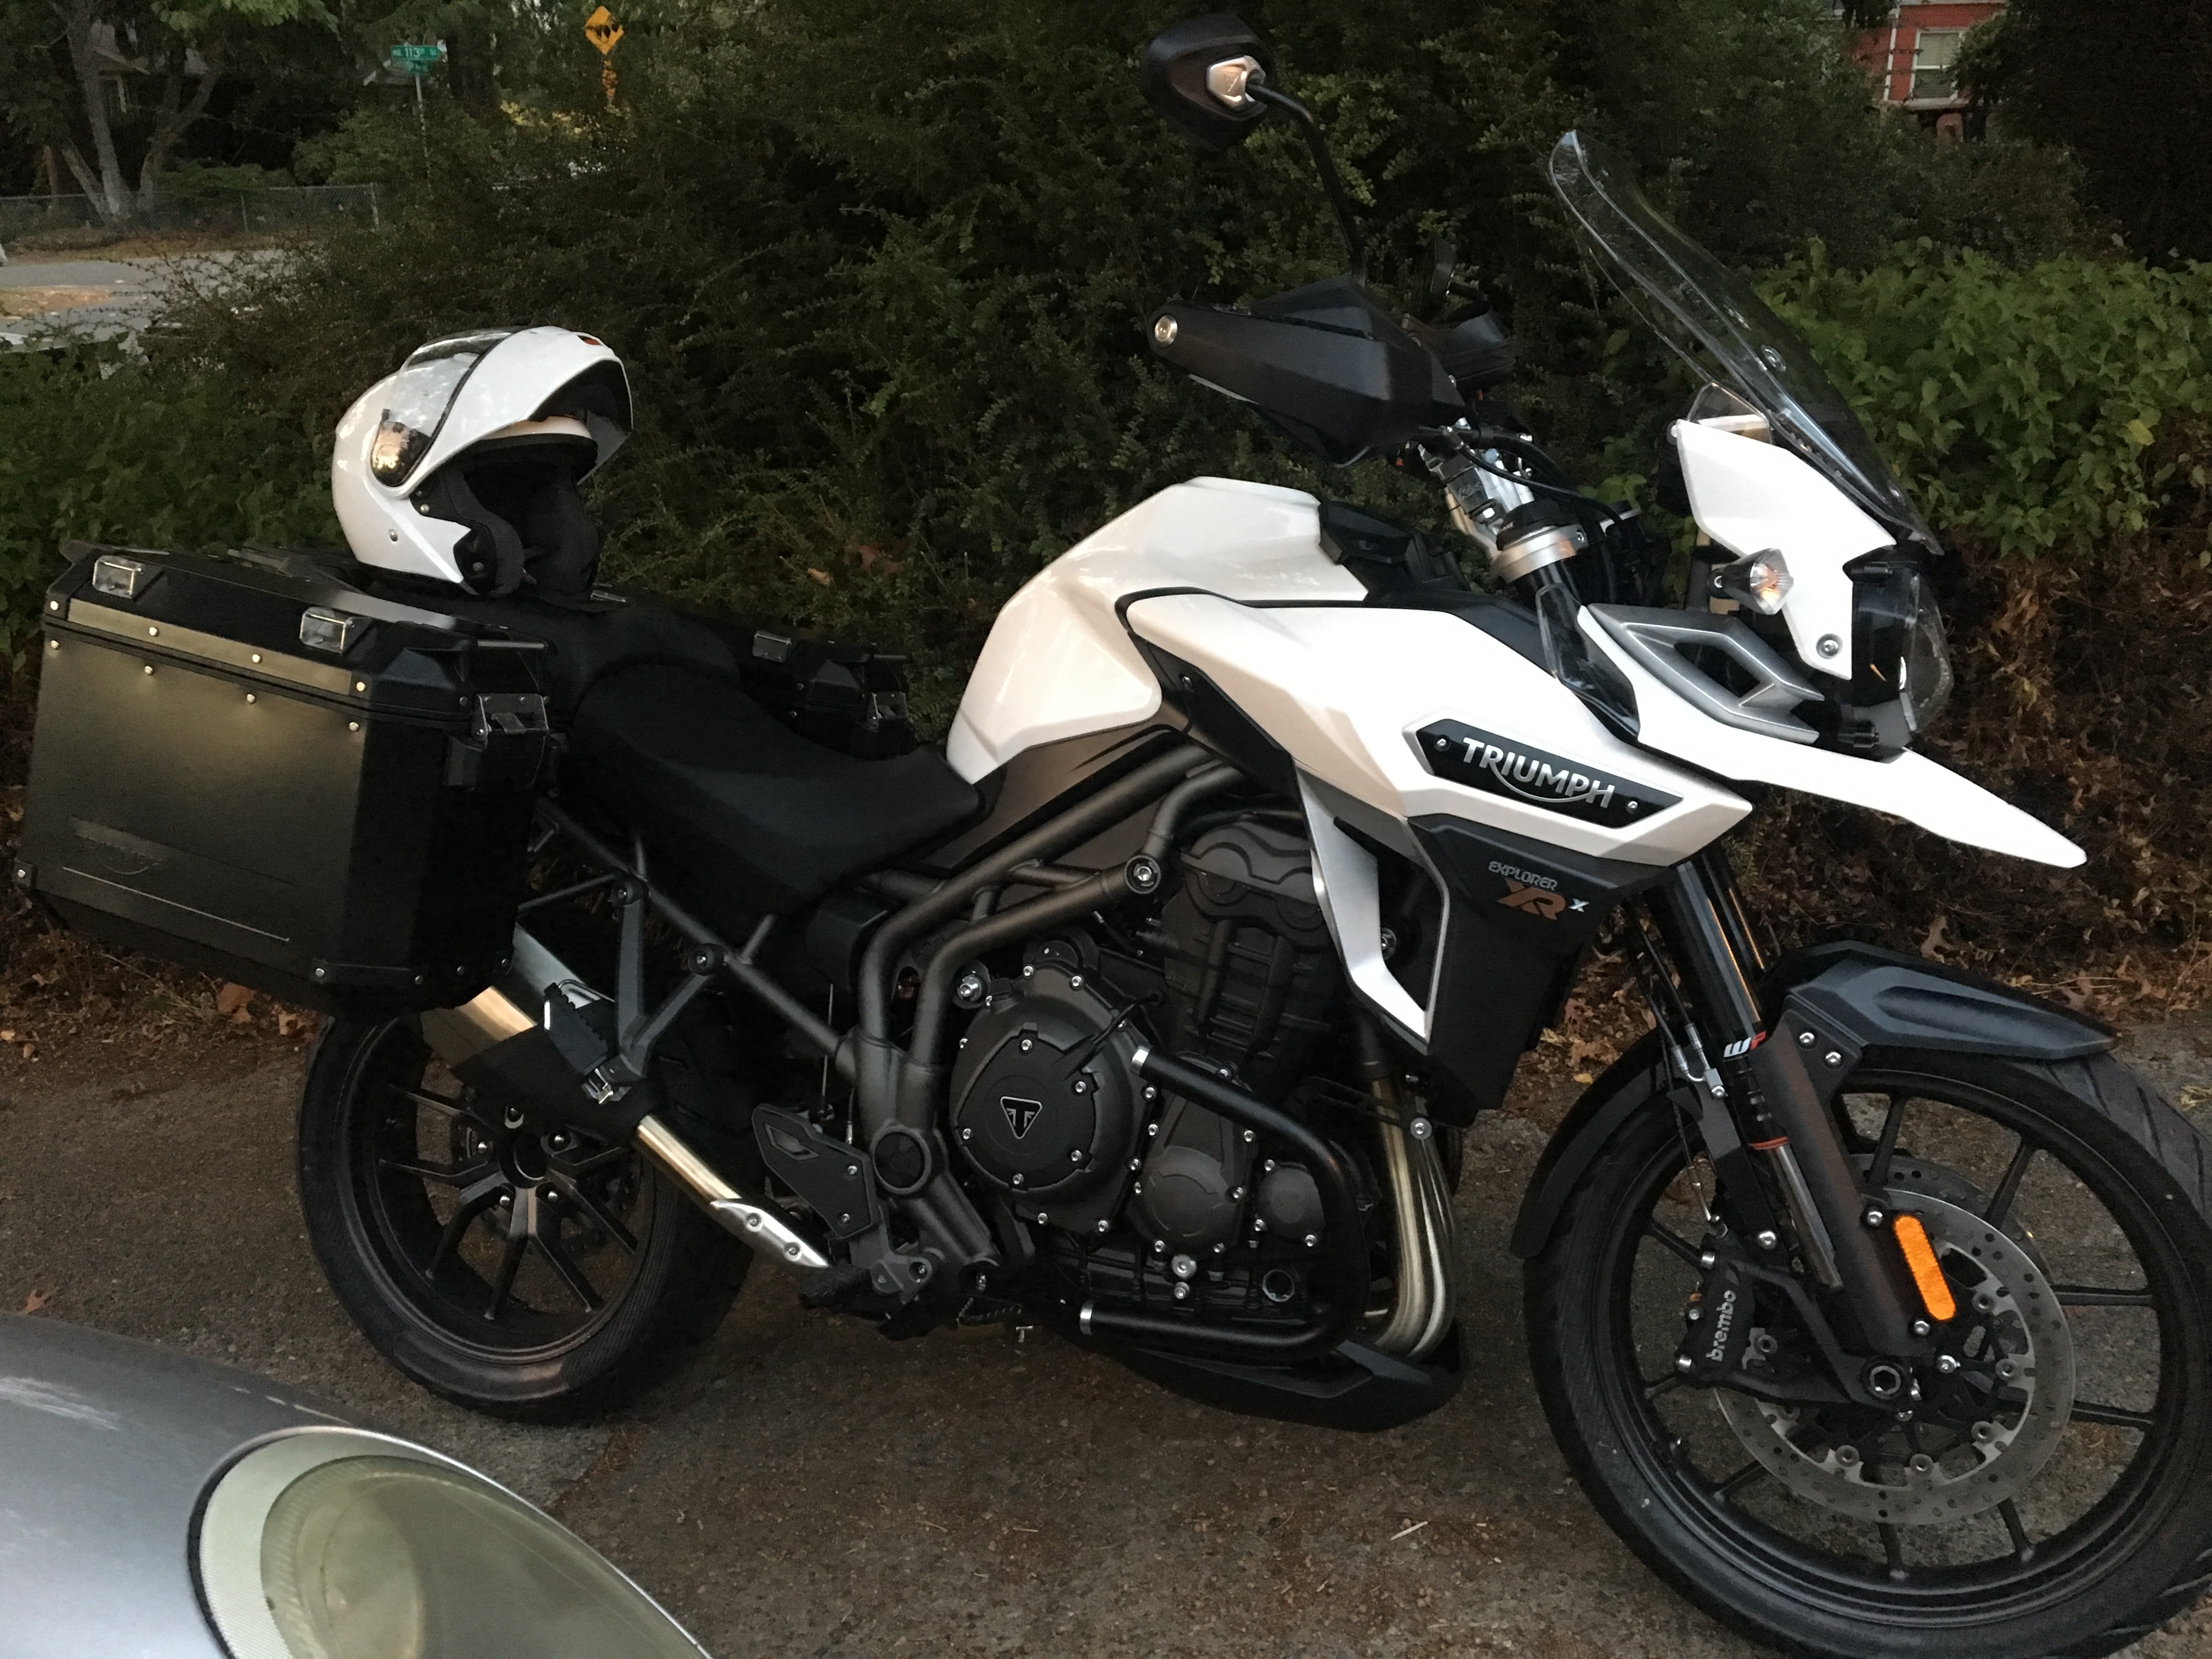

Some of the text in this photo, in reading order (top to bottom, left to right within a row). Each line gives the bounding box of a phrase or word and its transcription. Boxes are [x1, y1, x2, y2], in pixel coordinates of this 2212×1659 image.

[1463, 737, 1616, 809] TRIUMPH
[1488, 860, 1558, 891] EXPLORER
[1705, 1290, 1737, 1362] brembo
